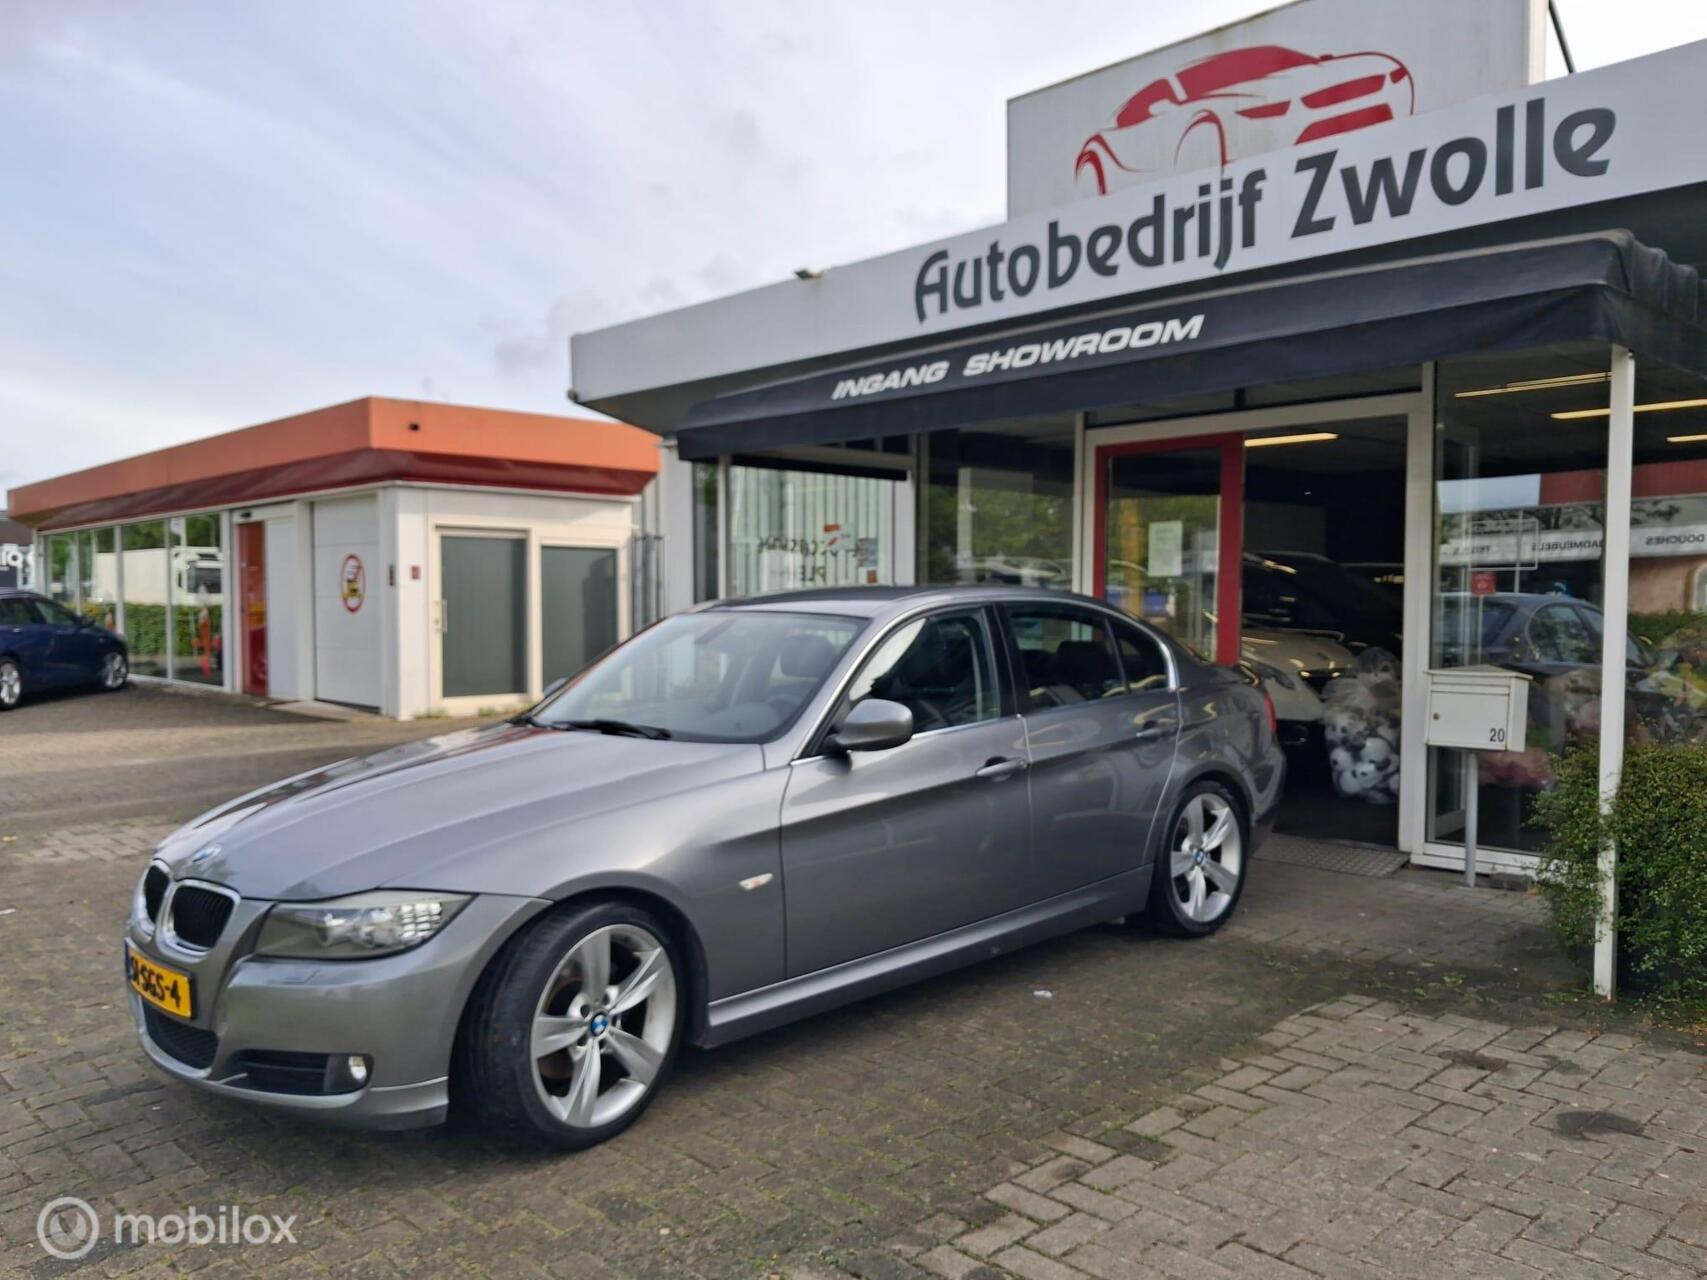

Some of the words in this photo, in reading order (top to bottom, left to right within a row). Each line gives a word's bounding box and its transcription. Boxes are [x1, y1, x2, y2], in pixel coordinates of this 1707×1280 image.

[914, 168, 1267, 324] Autobedrijf
[1290, 97, 1616, 240] Zwolle
[830, 361, 950, 400] INGANG
[963, 314, 1205, 377] SHOWROOM
[1489, 727, 1505, 743] 20
